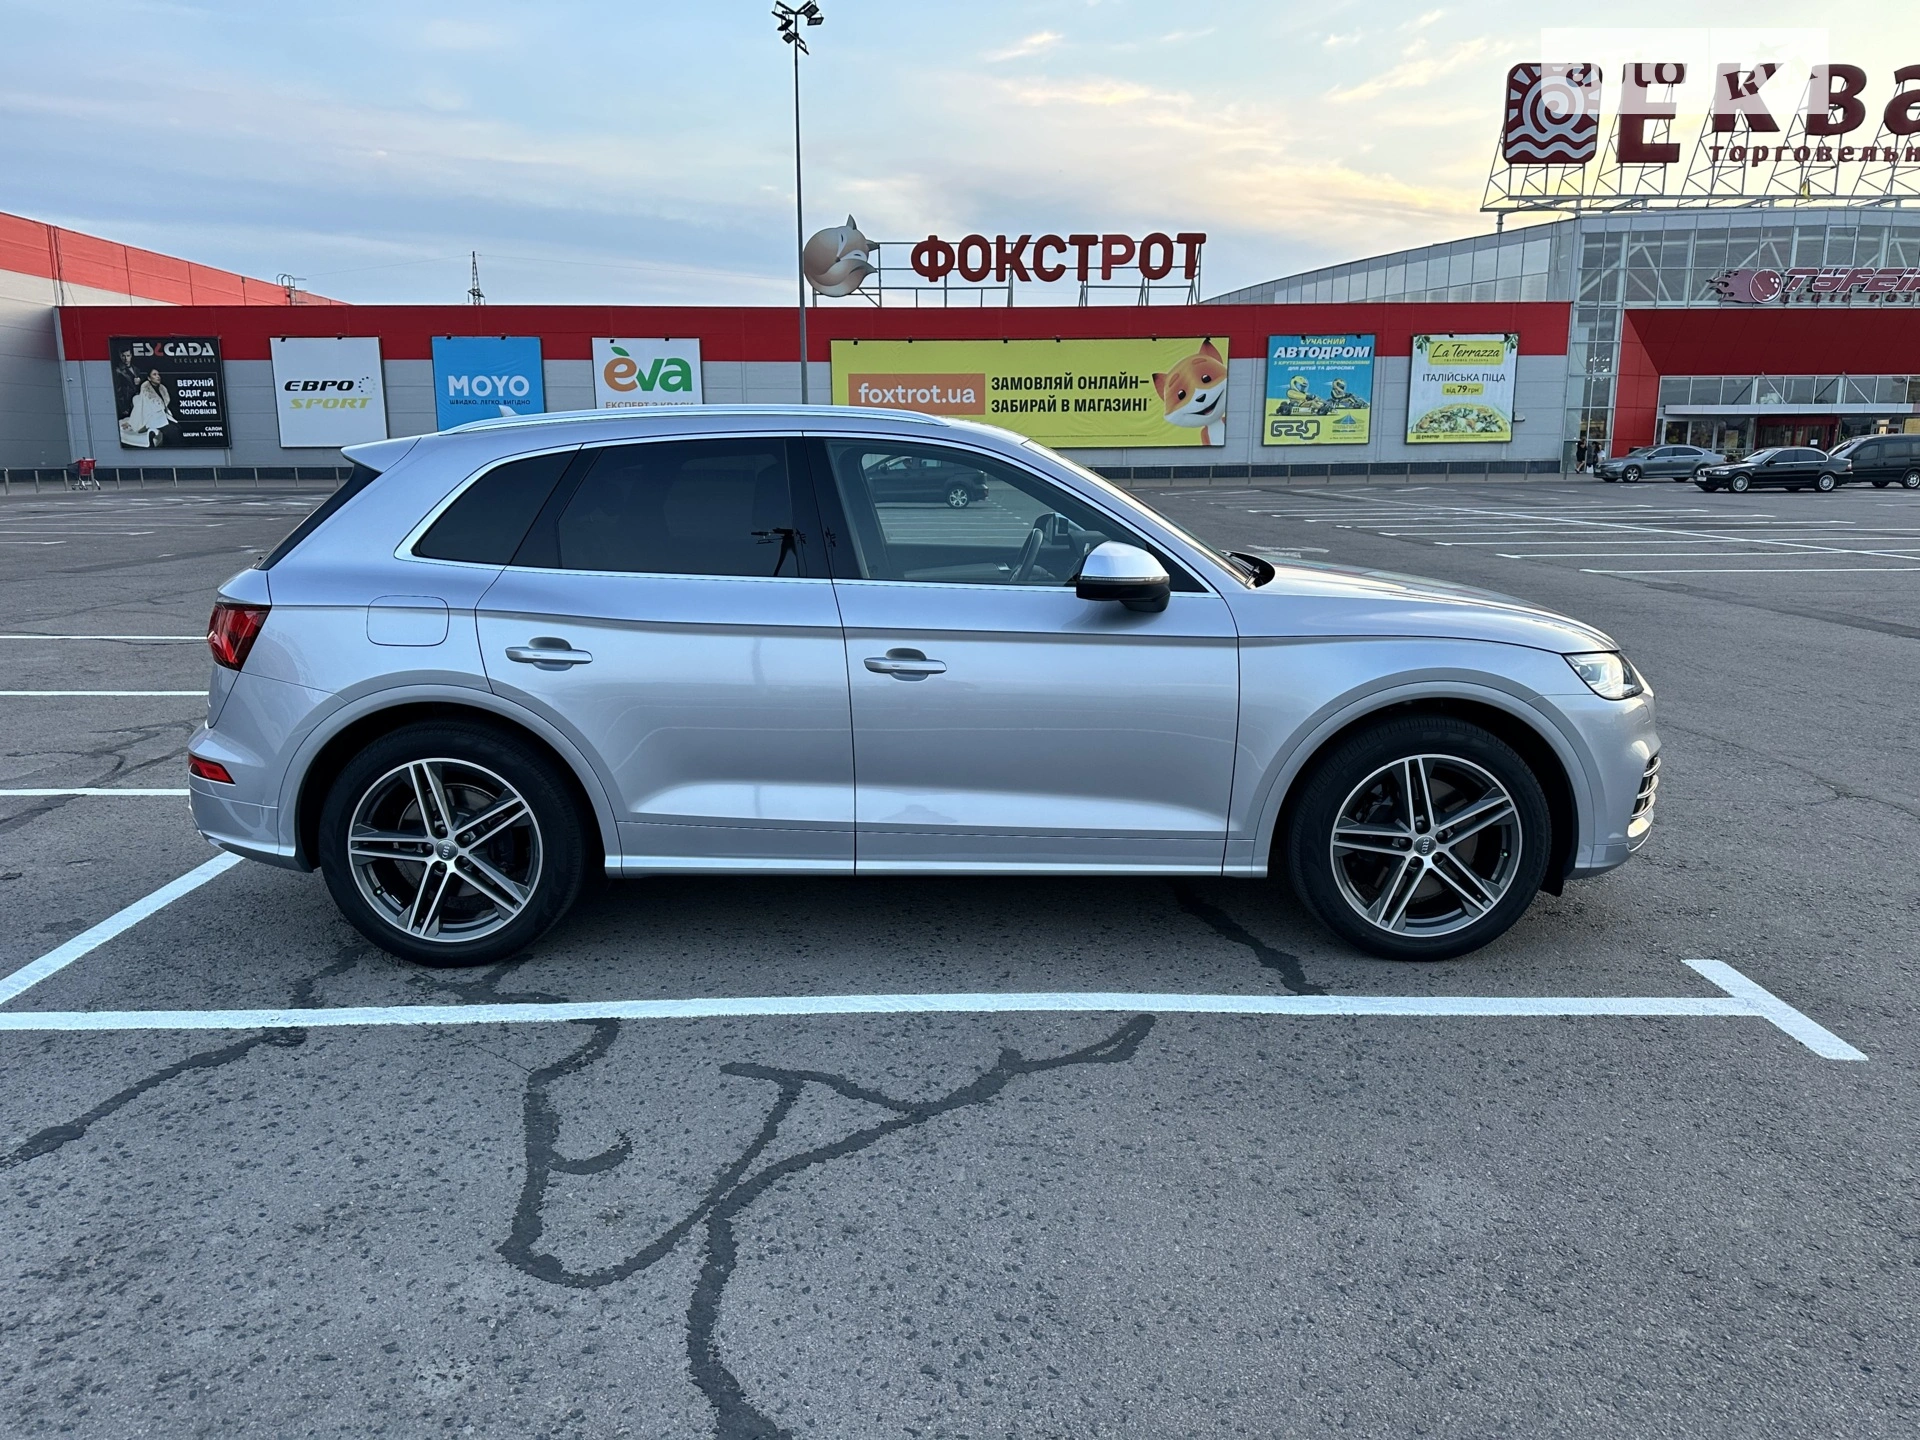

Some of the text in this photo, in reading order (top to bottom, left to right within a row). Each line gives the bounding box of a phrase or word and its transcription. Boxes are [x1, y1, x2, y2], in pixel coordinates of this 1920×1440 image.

[910, 232, 1207, 283] ФОКСТРОТ
[1273, 346, 1370, 359] АВТОДРОМ
[1431, 343, 1500, 359] La Terrazza
[177, 378, 214, 387] ВЕРХНІЙ
[991, 372, 1073, 391] ЗАМОВЛЯЙ
[1422, 372, 1506, 383] ІТАЛІЙСЬКА ПІЦА
[284, 380, 355, 392] ЕВРО
[447, 375, 530, 397] MOYO
[1457, 385, 1468, 393] 79
[178, 390, 201, 398] ОДЯГ
[858, 382, 976, 404] foxtrot.ua
[290, 397, 373, 410] SPORT
[991, 395, 1058, 413] ЗАБИРАЙ
[1061, 399, 1070, 412] В
